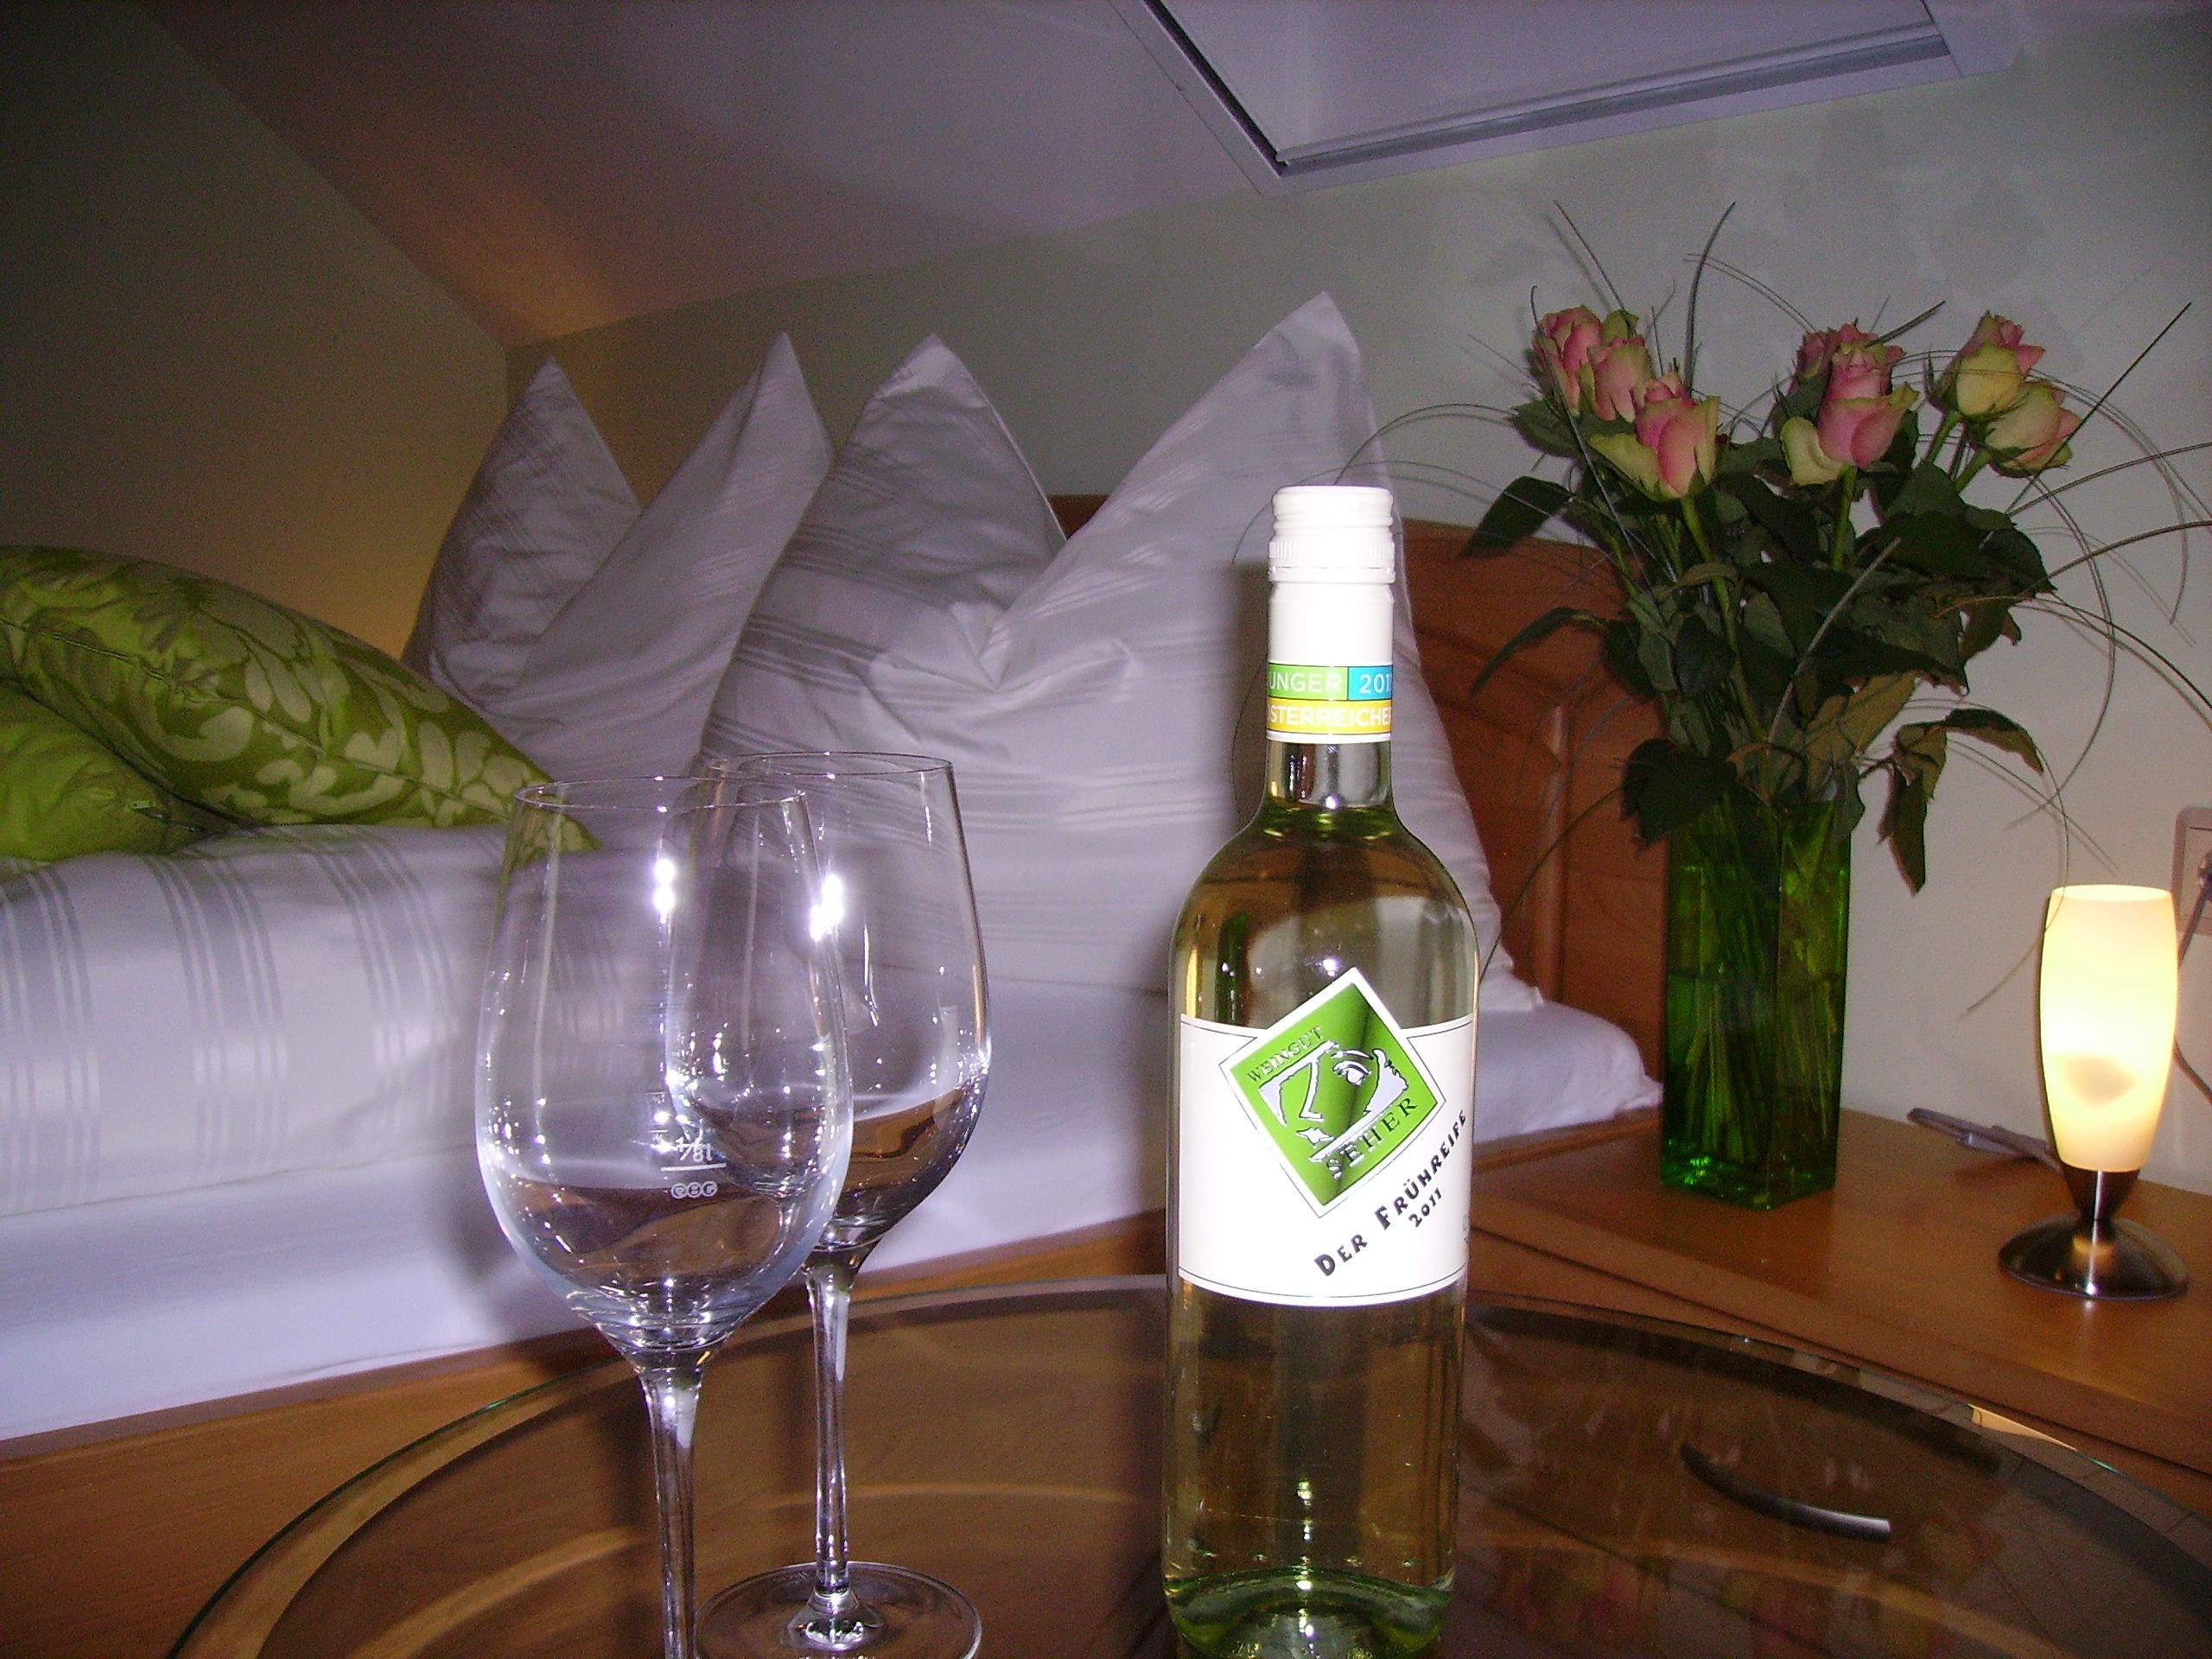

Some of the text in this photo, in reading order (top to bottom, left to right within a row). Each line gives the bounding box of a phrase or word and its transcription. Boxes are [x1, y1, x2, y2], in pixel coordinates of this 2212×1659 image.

[1247, 1026, 1320, 1082] WEINGUT
[1325, 1097, 1418, 1180] SEHER
[1314, 1109, 1466, 1276] DER FRÜHREIFE
[1408, 1187, 1442, 1228] 2011
